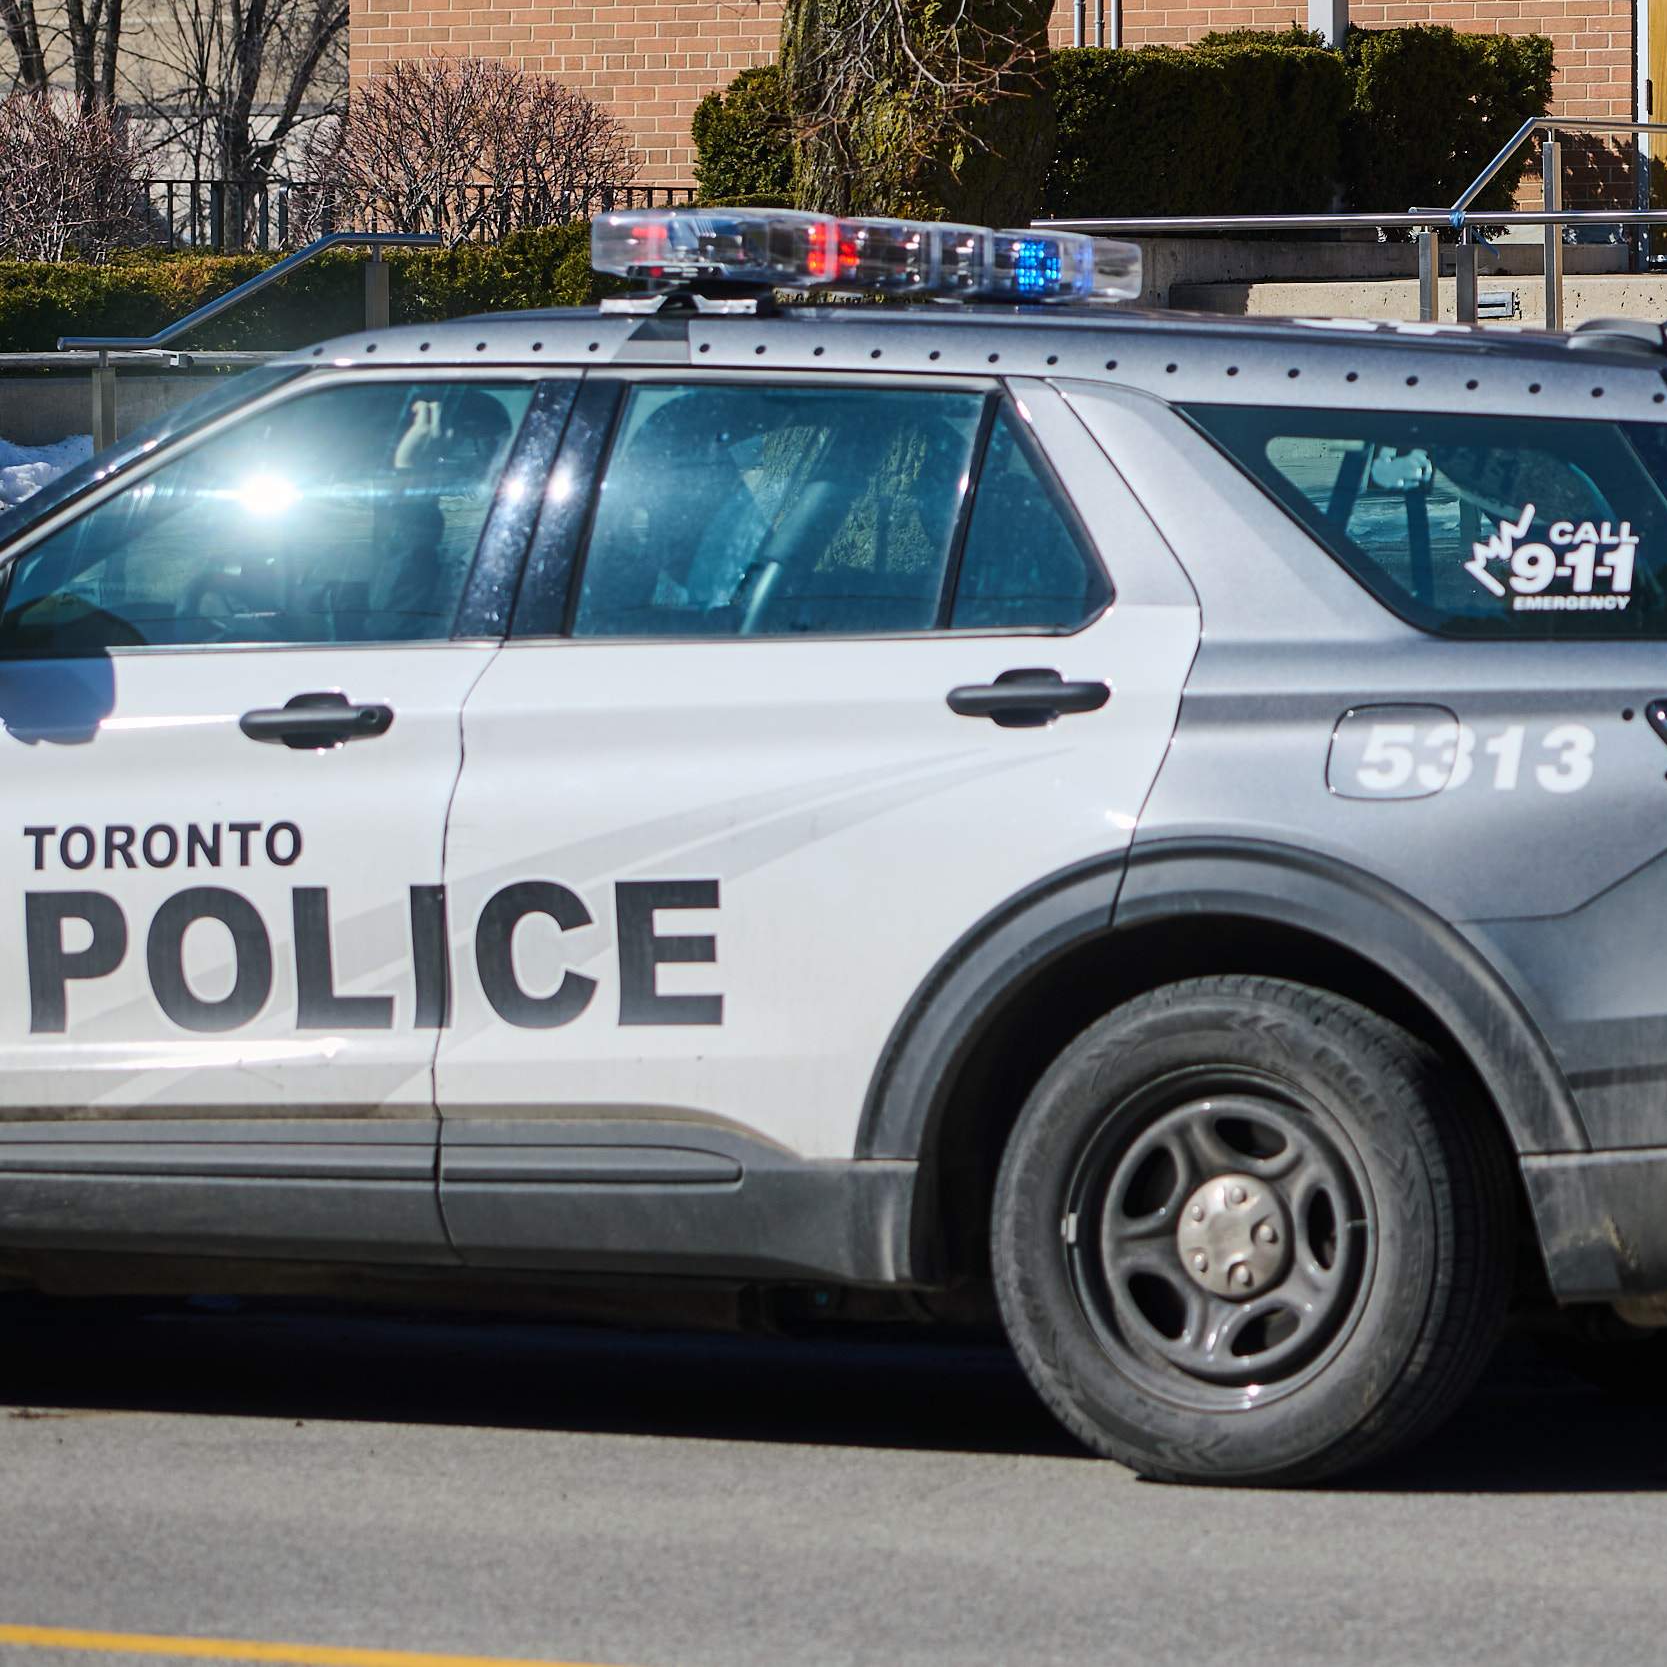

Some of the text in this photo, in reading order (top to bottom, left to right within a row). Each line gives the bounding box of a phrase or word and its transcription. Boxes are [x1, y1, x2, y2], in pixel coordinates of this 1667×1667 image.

[1549, 521, 1640, 544] CALL
[1509, 542, 1636, 594] 9-1-1
[1512, 595, 1631, 611] EMERGENCY
[1356, 723, 1596, 794] 5313
[23, 821, 304, 871] TORONTO
[24, 878, 725, 1034] POLICE
